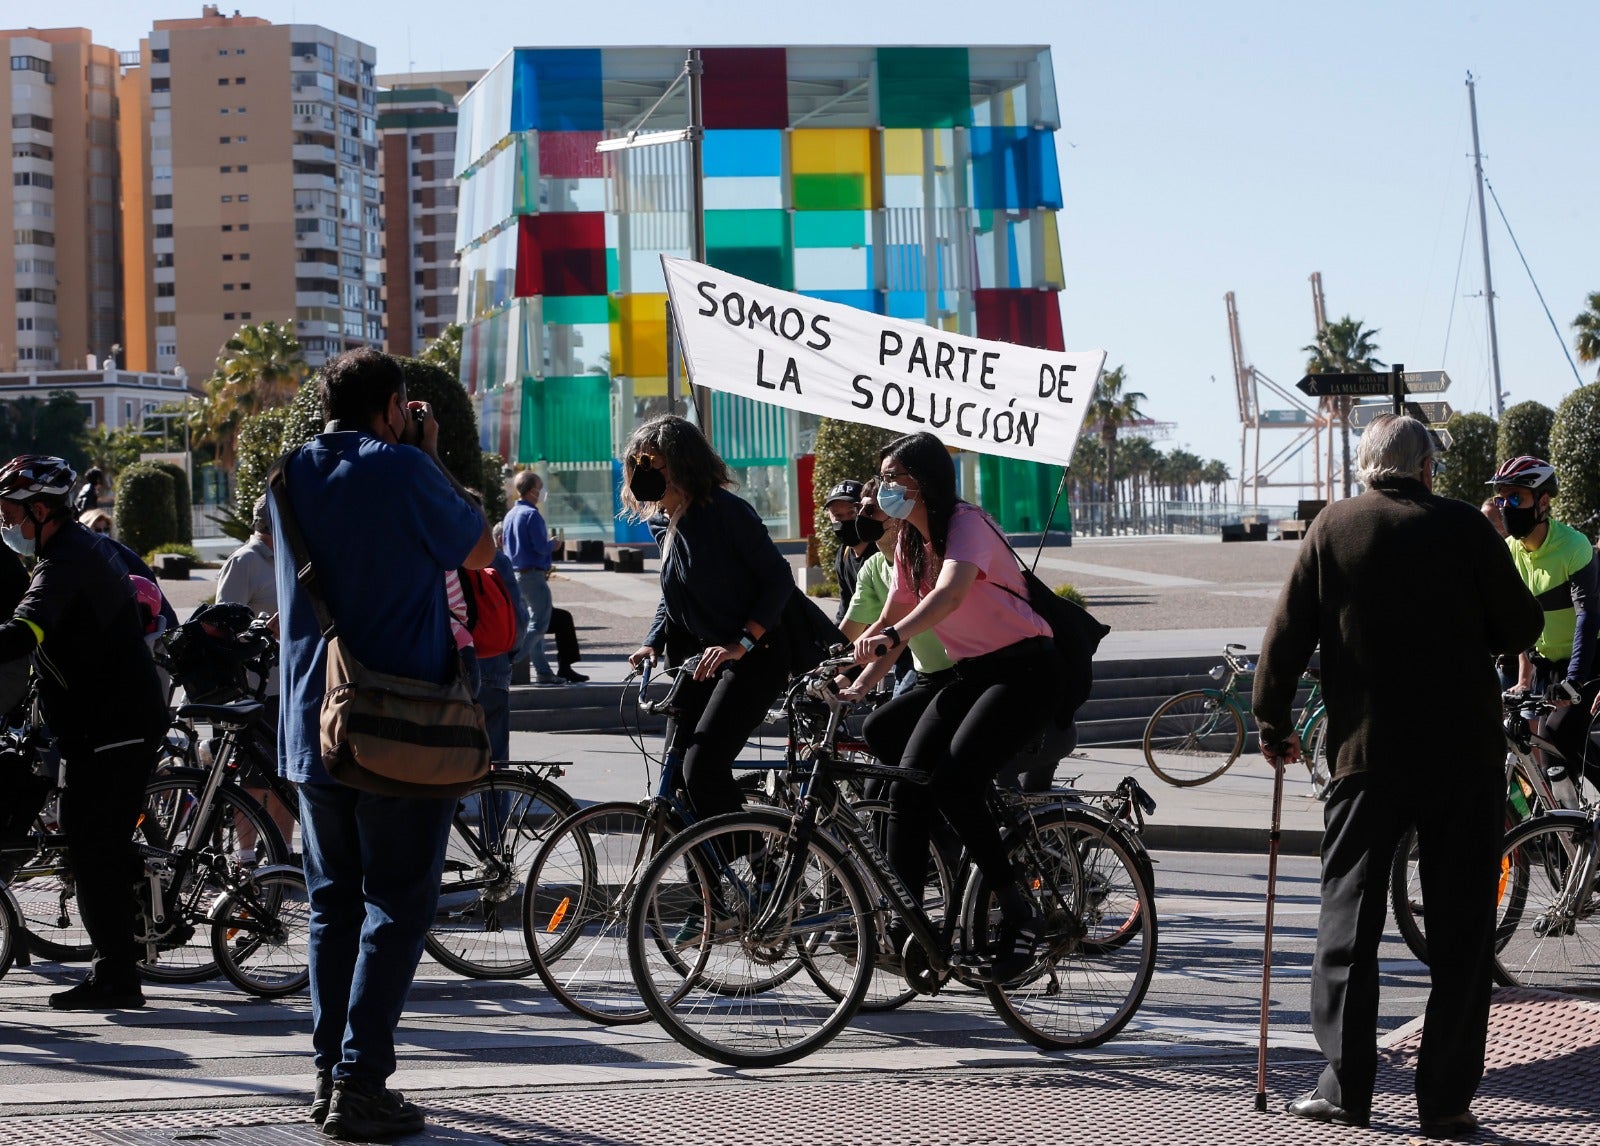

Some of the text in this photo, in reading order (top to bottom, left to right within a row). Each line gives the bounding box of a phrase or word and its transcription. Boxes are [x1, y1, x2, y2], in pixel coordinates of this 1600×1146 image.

[696, 281, 1077, 403] SOMOS PARTE DE
[756, 349, 1039, 447] LA SOLUCIÓN
[1330, 383, 1386, 393] LA MALAGUETA
[853, 826, 916, 908] TORPADO
